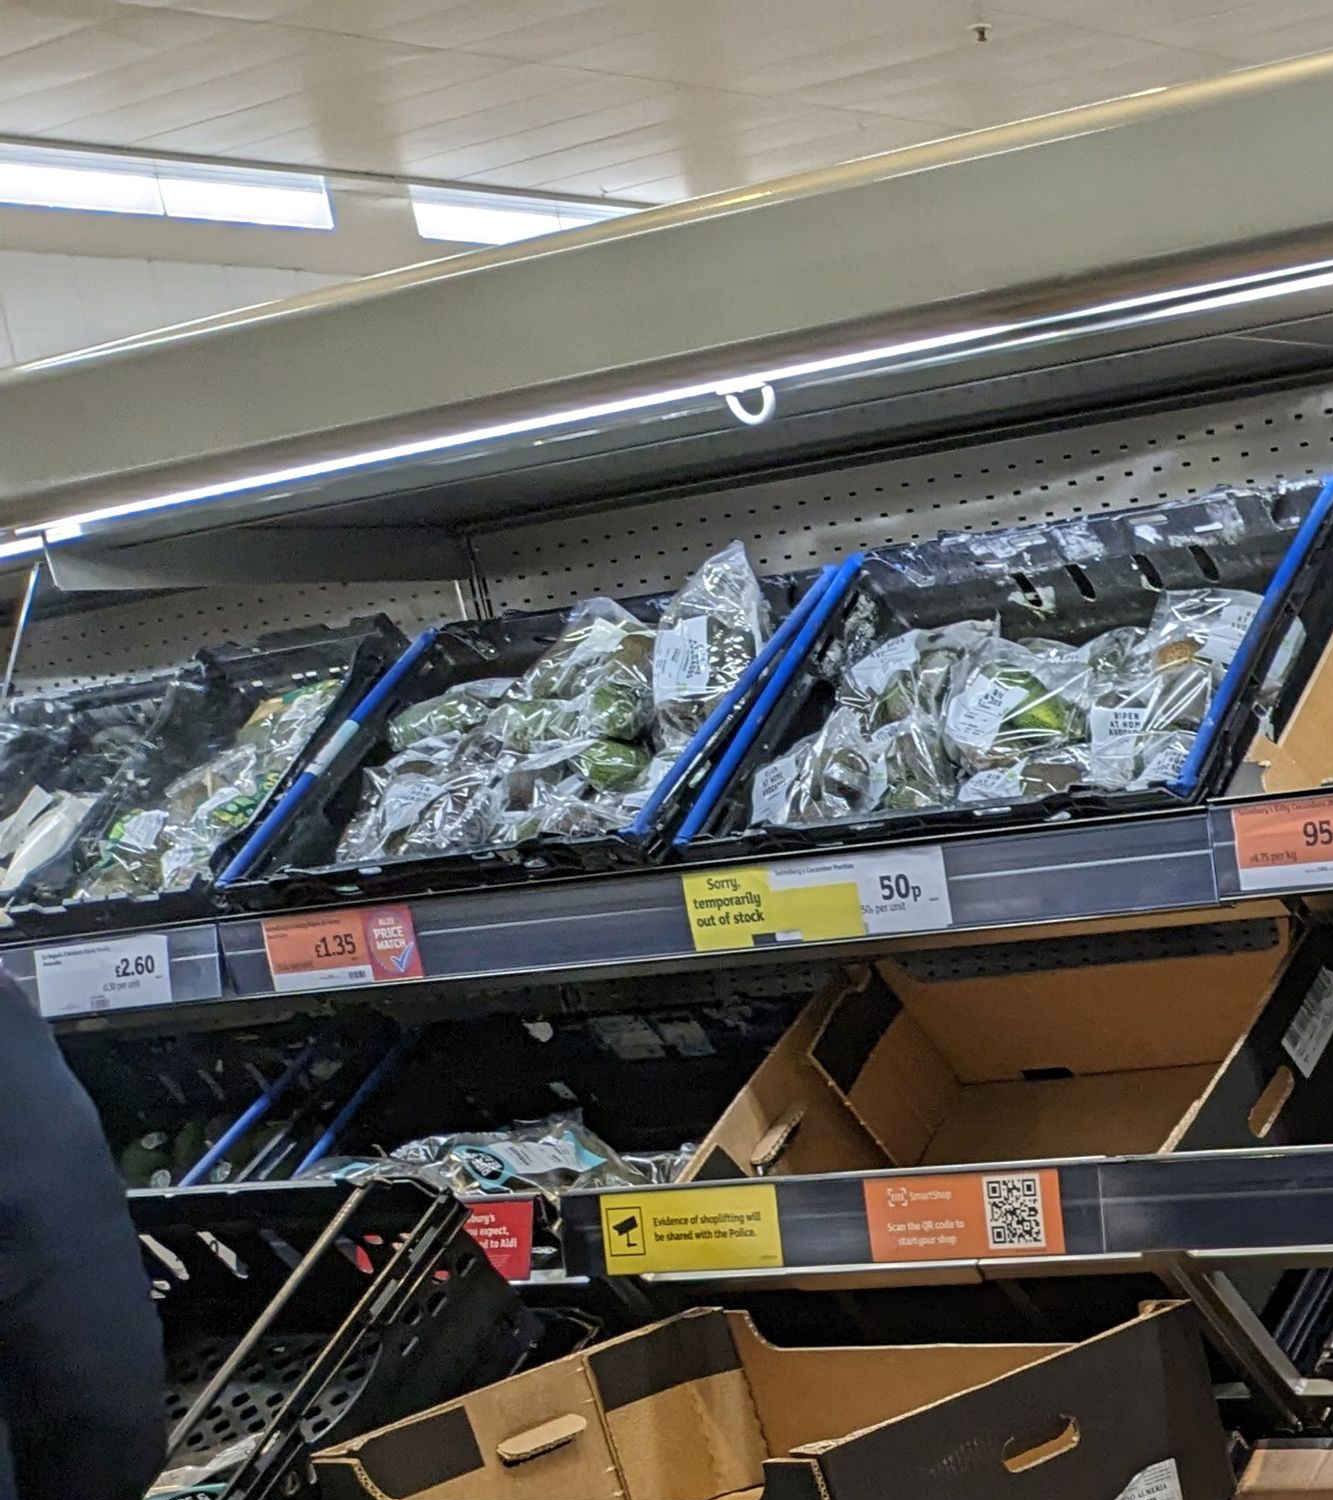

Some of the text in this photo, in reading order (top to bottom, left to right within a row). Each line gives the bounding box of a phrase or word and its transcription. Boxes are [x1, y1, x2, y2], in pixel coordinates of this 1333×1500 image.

[707, 878, 741, 891] Sorry,
[879, 874, 921, 902] 50p
[694, 893, 761, 910] temporarily
[697, 909, 764, 927] out of stock
[373, 927, 404, 939] PRICE
[315, 933, 356, 958] £1.35
[376, 939, 406, 950] MATCH
[115, 955, 154, 978] £2.60
[653, 1216, 687, 1227] Evidence
[700, 1212, 744, 1225] shoplifting
[887, 1222, 906, 1232] Scan
[666, 1230, 693, 1240] shared
[695, 1229, 712, 1239] with
[729, 1228, 757, 1238] Police.
